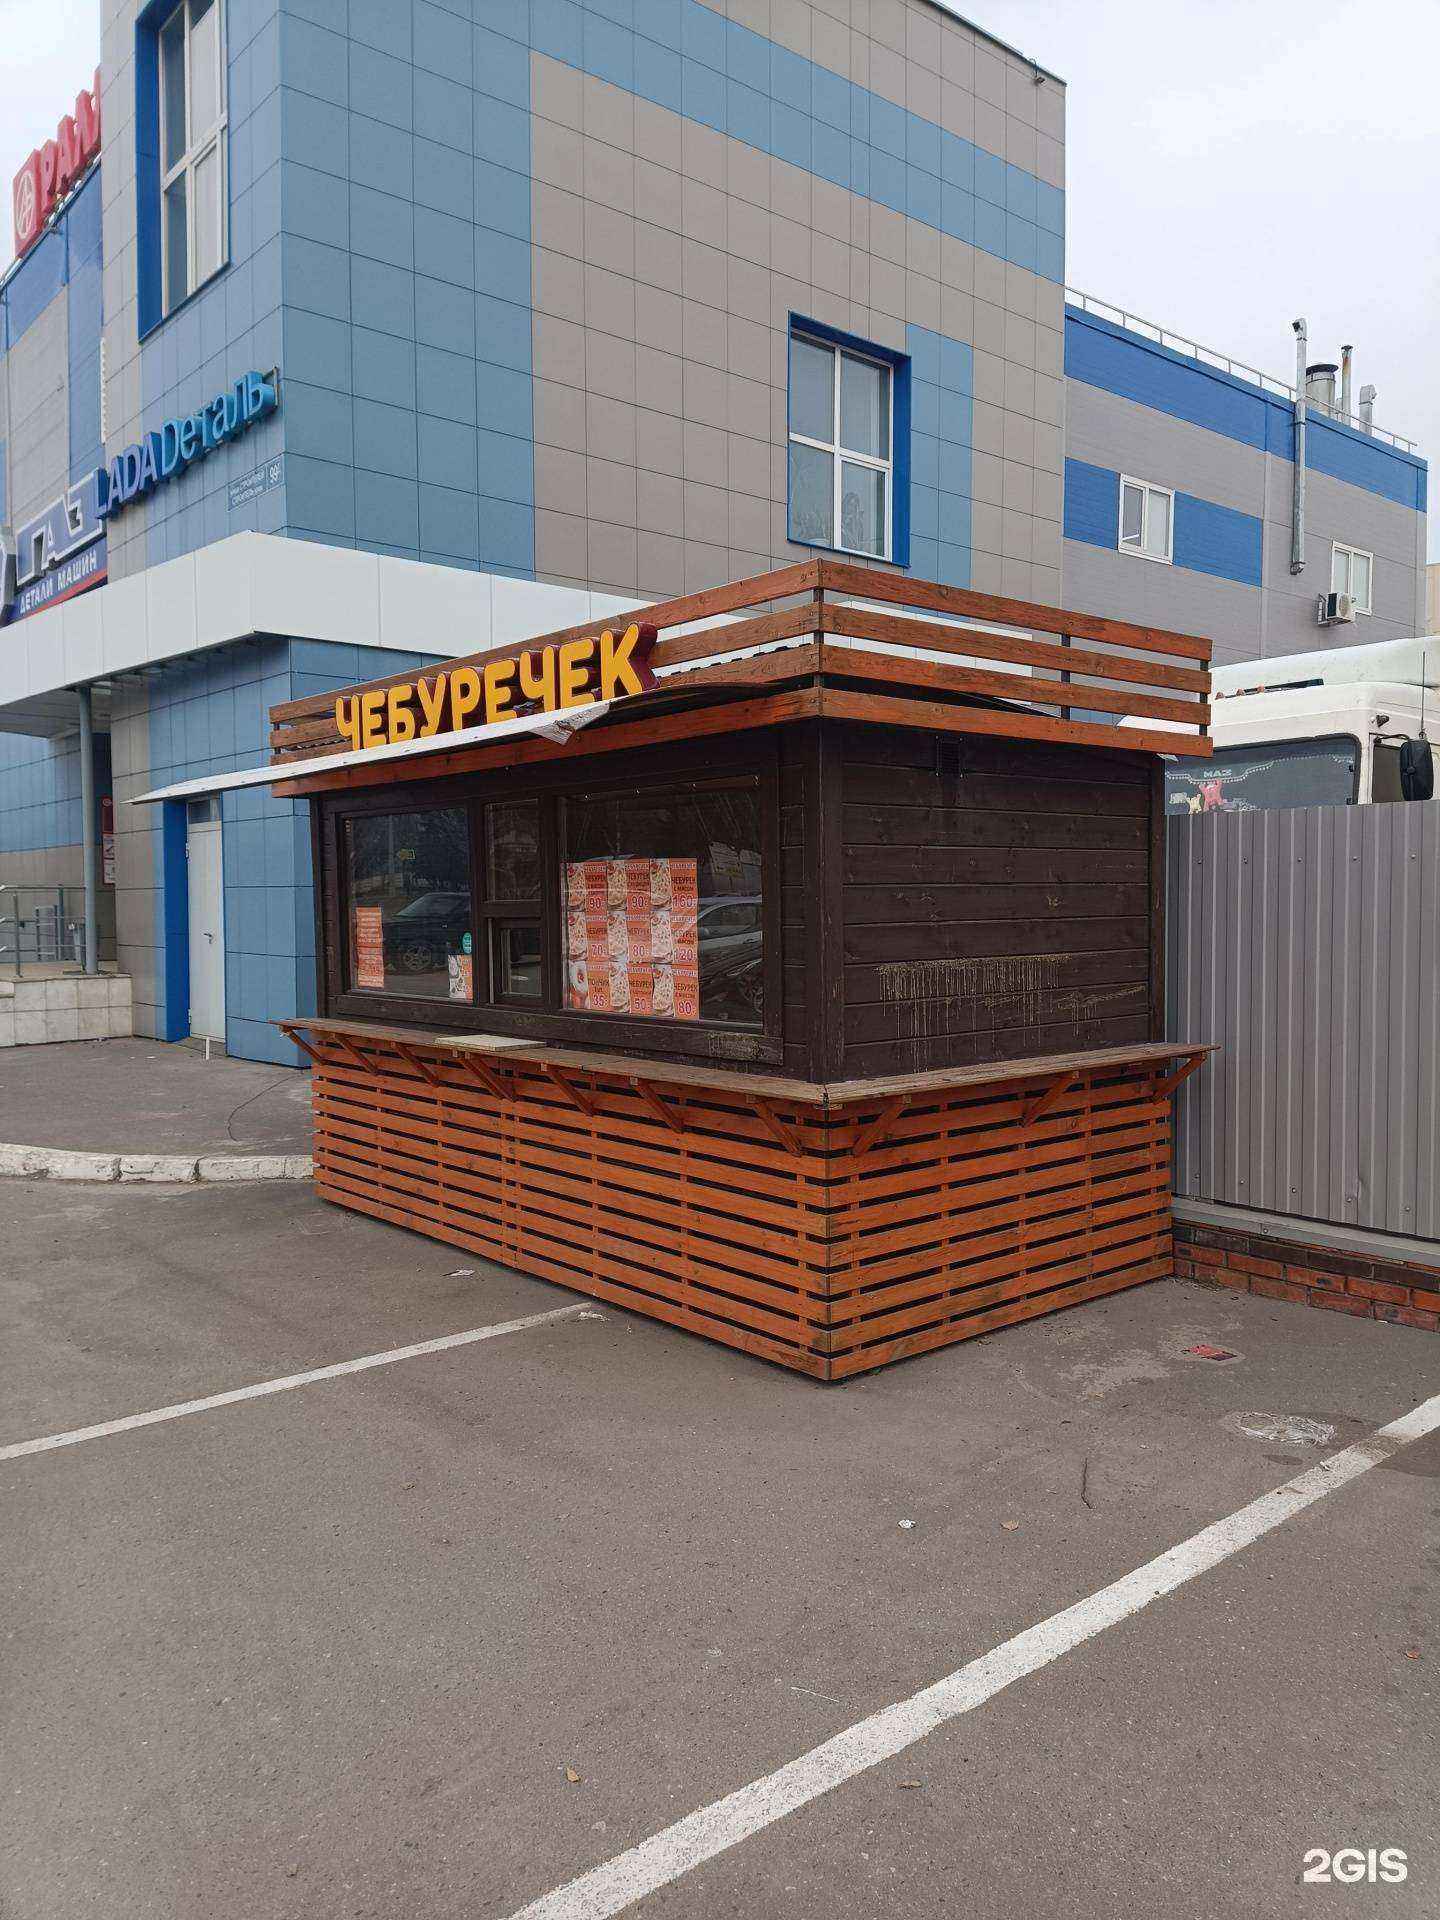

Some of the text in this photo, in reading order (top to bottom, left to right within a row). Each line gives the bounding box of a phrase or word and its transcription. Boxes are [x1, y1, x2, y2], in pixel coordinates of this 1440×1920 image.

[19, 549, 98, 614] ДЕТАЛИ МАШИН
[335, 622, 653, 751] ЧЕБУРЕЧЕК
